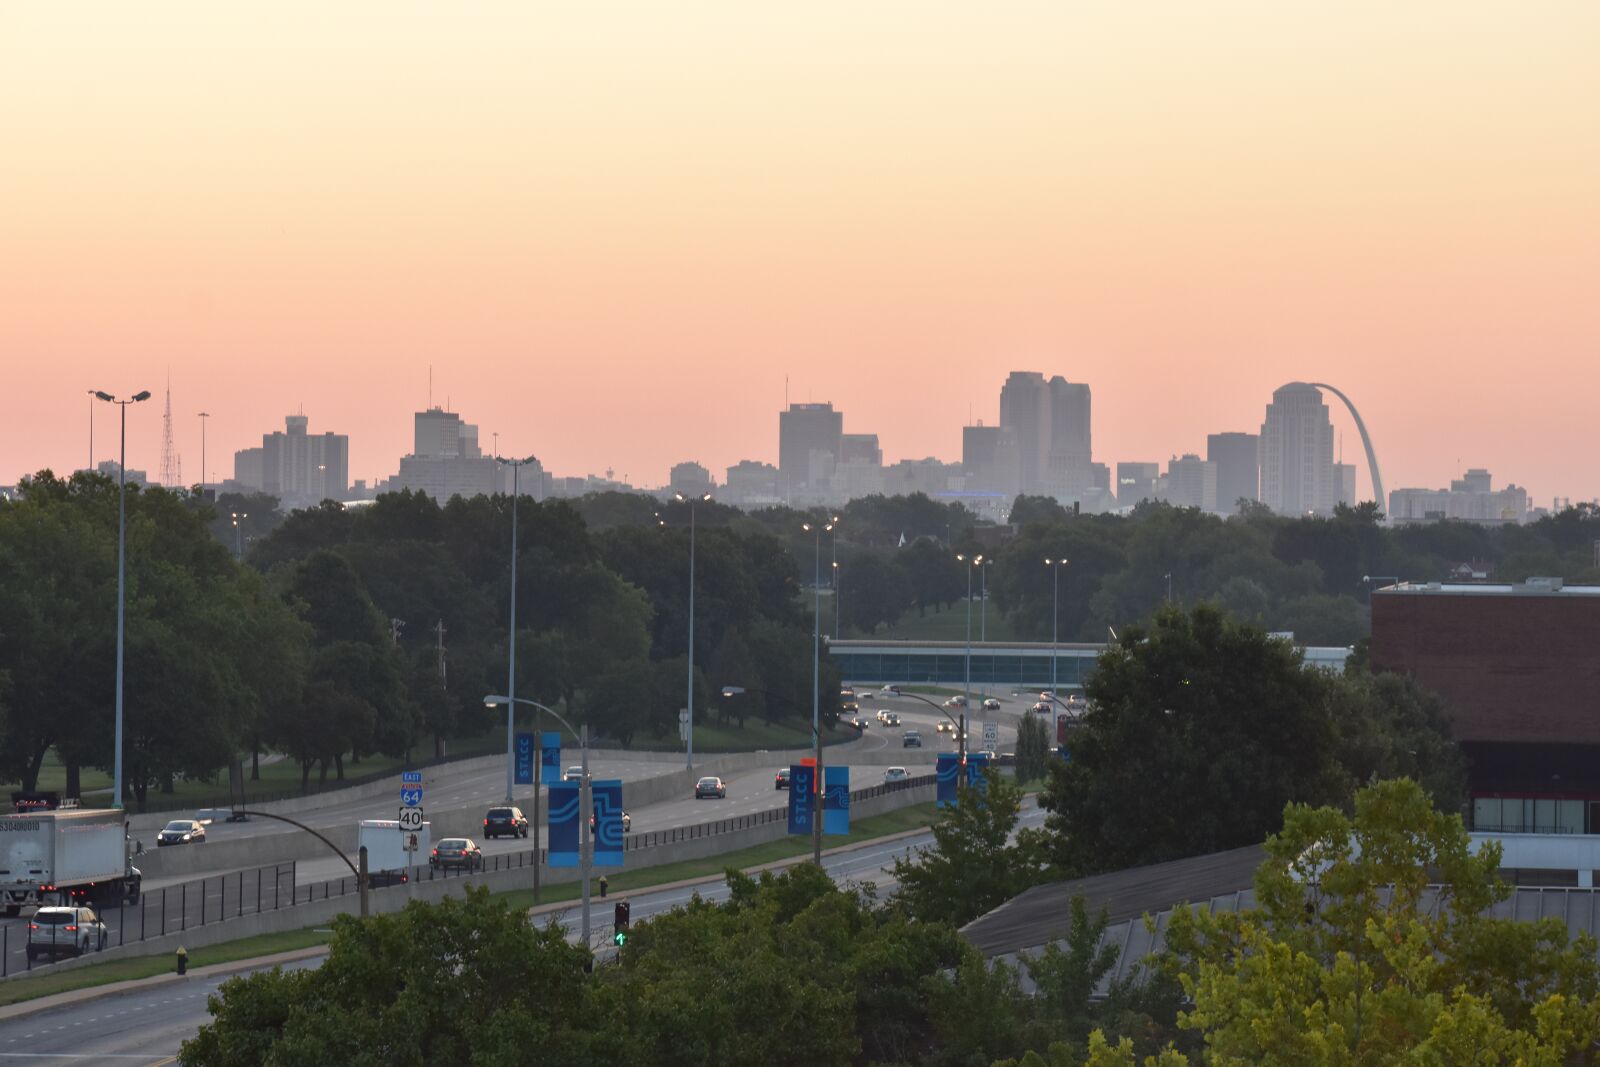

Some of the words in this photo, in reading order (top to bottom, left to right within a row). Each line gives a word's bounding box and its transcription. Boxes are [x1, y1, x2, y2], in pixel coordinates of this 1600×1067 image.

[520, 738, 529, 777] STLCC
[404, 773, 419, 781] EAST
[403, 791, 419, 803] 64
[795, 774, 808, 825] STLCC
[401, 812, 421, 825] 40
